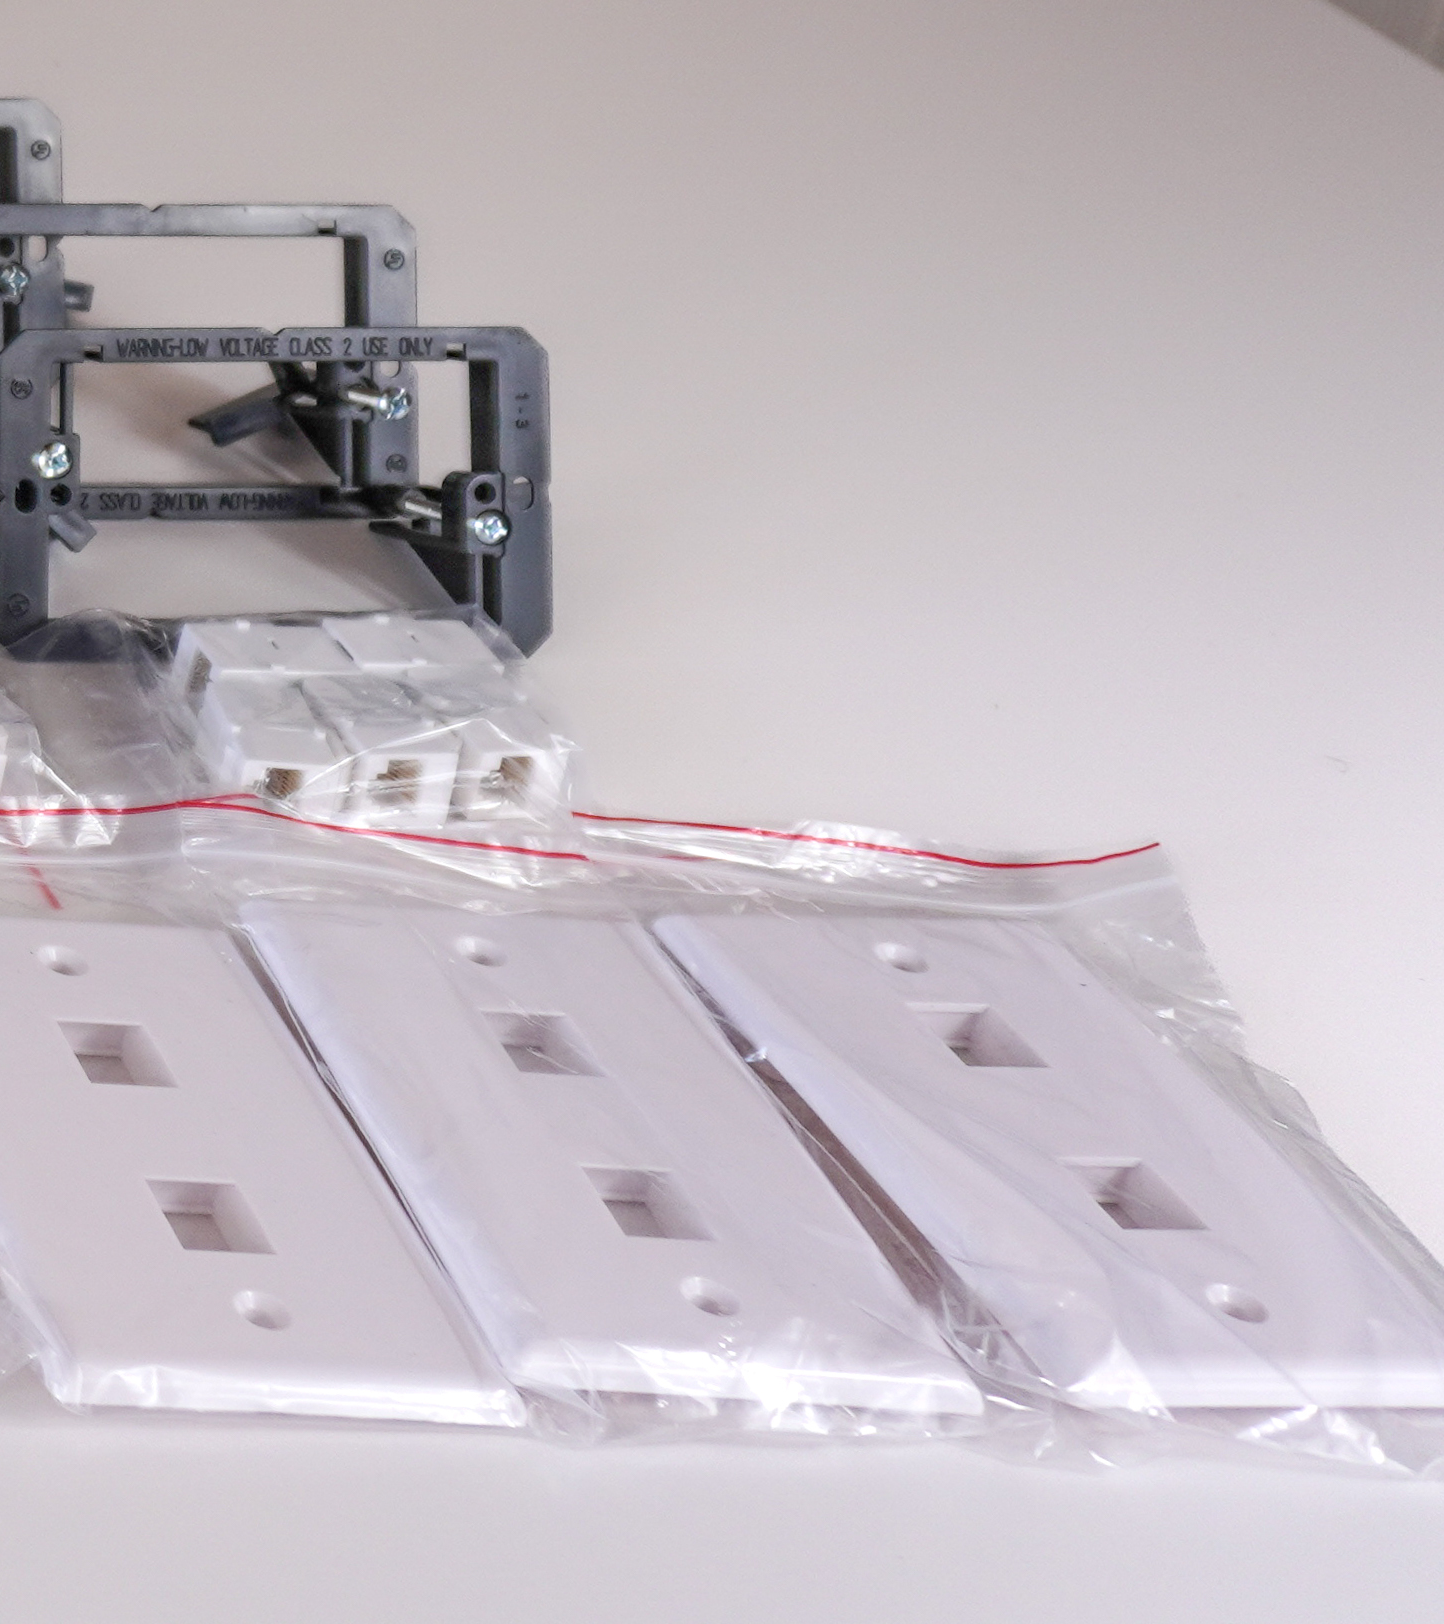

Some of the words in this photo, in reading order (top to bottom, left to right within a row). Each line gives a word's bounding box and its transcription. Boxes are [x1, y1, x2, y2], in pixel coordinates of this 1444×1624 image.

[220, 337, 280, 357] VOLTAGE
[289, 337, 333, 357] CLASS
[343, 337, 352, 356] 2
[362, 337, 388, 357] USE
[399, 337, 434, 357] ONLY
